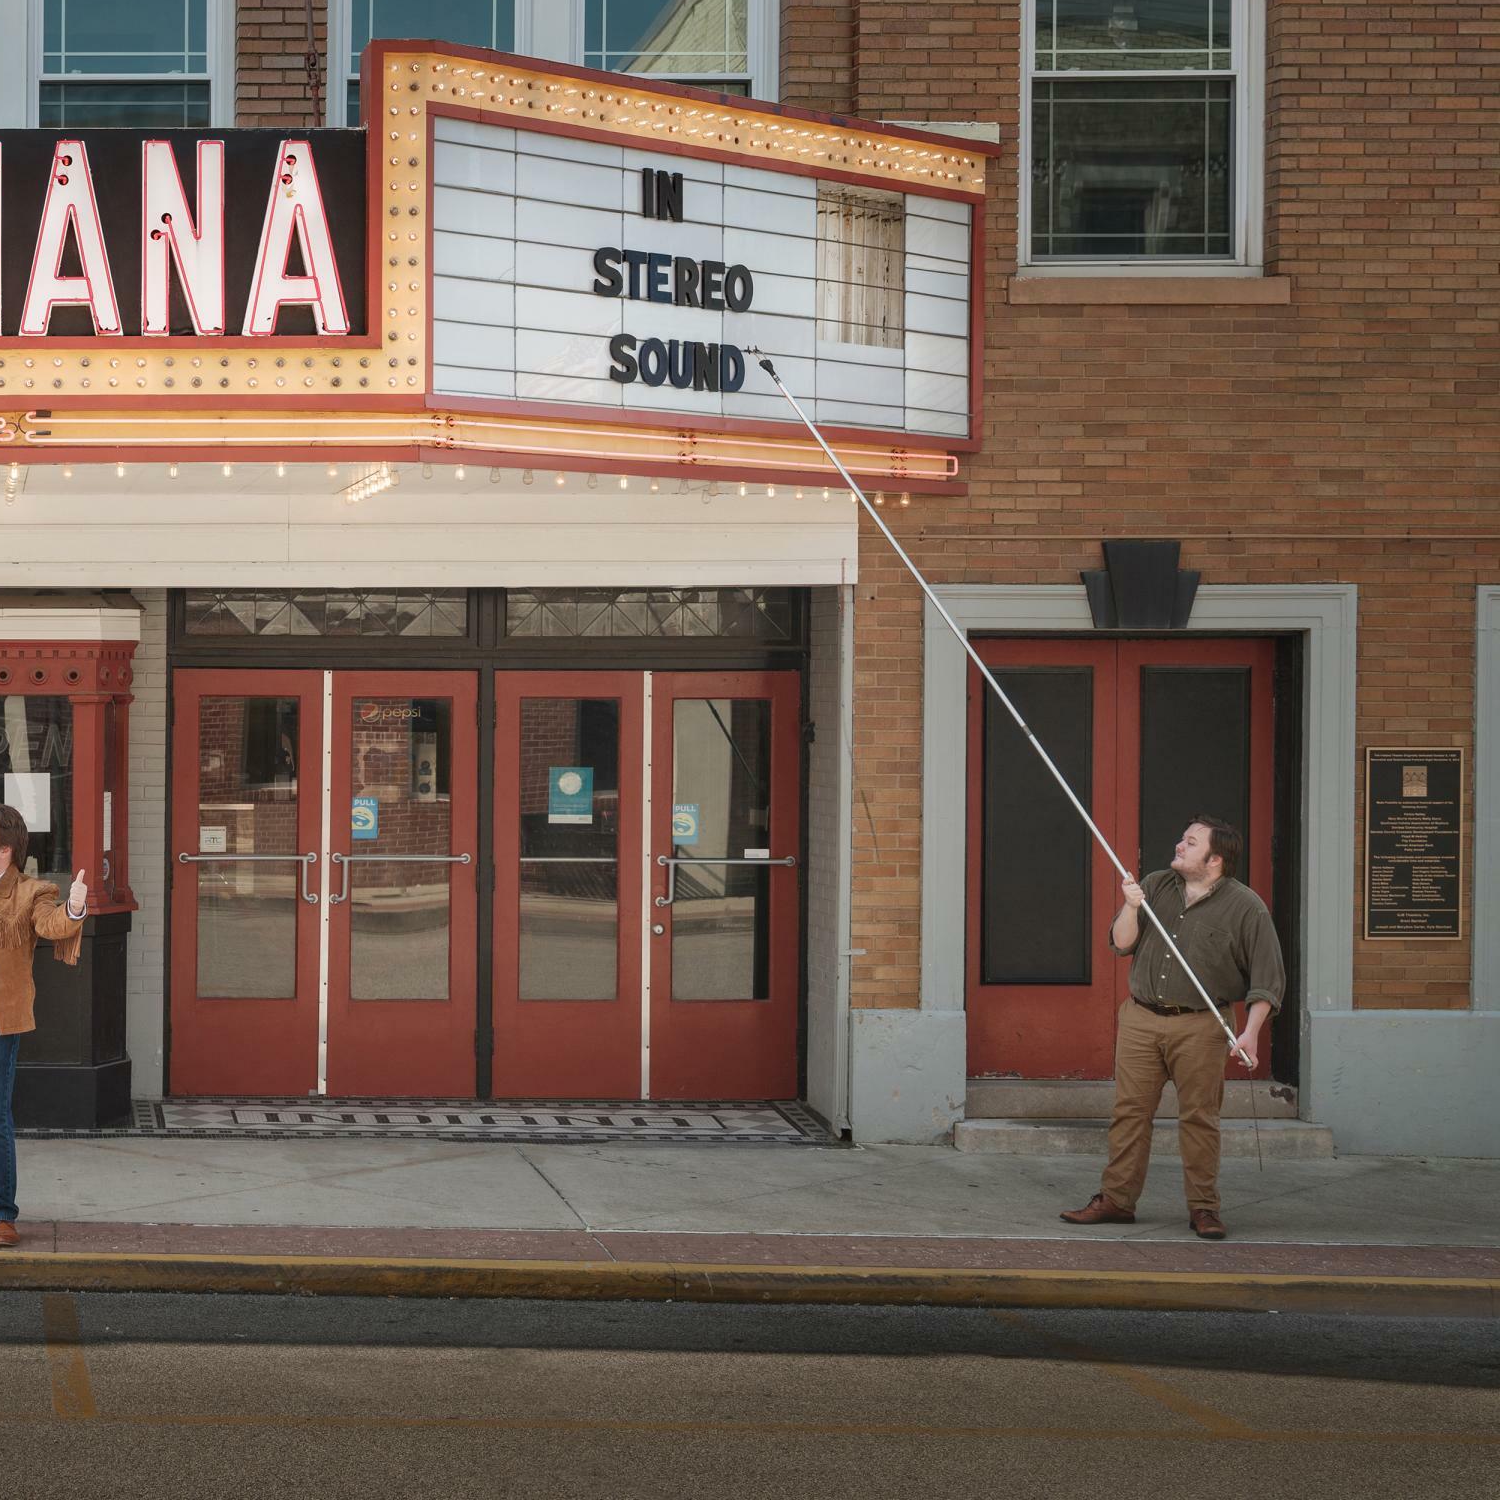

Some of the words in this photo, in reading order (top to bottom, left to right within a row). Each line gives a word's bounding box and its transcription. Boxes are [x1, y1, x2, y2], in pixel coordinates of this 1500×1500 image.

[642, 167, 683, 223] IN
[592, 246, 754, 313] STEREO
[609, 333, 745, 393] SOUND
[382, 706, 421, 719] pepsi
[354, 798, 376, 806] PULL
[675, 805, 697, 813] PULL
[262, 1112, 693, 1127] INDIANA
